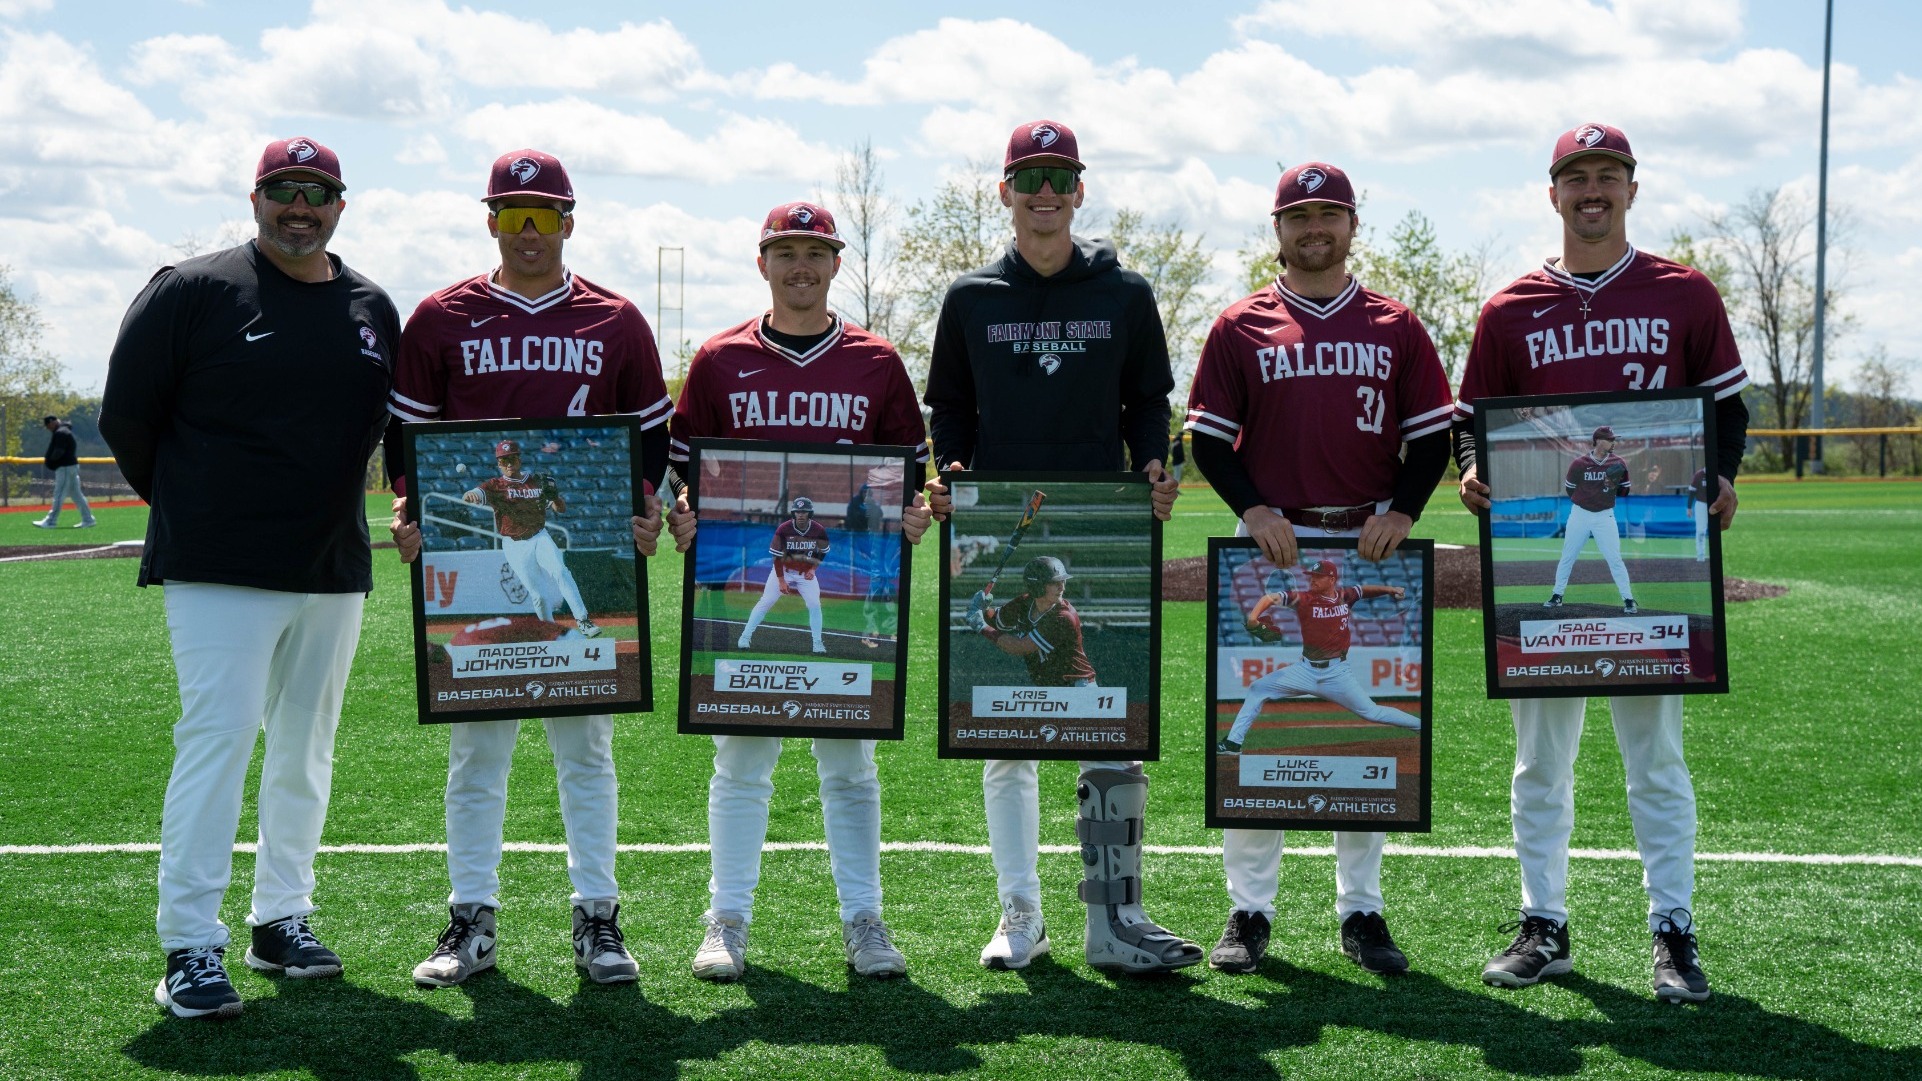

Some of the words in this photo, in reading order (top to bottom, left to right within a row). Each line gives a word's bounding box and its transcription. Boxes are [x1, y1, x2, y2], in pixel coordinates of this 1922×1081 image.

[987, 321, 1061, 343] FAIRMONT
[1066, 320, 1112, 339] STATE
[1013, 342, 1086, 352] BASEBALL
[1525, 317, 1670, 369] FALCONS
[460, 335, 604, 376] FALCONS
[1256, 341, 1392, 384] FALCONS
[566, 383, 590, 417] 4
[728, 390, 870, 432] FALCONS
[1356, 385, 1386, 435] 31
[786, 541, 817, 550] FALCONS
[1312, 603, 1349, 618] FALCONS
[1557, 622, 1607, 633] ISAAC
[1649, 624, 1685, 640] 34
[1523, 634, 1566, 648] VAN
[1571, 632, 1644, 647] METER
[478, 645, 548, 658] MADDOX
[584, 647, 601, 661] 4
[457, 655, 570, 673] JOHNSTON
[739, 664, 808, 675] CONNOR
[1506, 664, 1594, 677] BASEBALL
[1618, 663, 1691, 676] ATHLETICS
[728, 675, 820, 691] BAILEY
[841, 672, 859, 686] 9
[437, 687, 525, 701] BASEBALL
[548, 684, 617, 697] ATHLETICS
[1012, 690, 1048, 700] KRIS
[697, 703, 781, 715] BASEBALL
[991, 700, 1069, 712] SUTTON
[1096, 695, 1114, 710] 11
[803, 708, 870, 720] ATHLETICS
[956, 728, 1038, 739] BASEBALL
[1060, 732, 1126, 743] ATHLETICS
[1276, 759, 1319, 769] LUKE
[1263, 769, 1334, 782] EMORY
[1362, 765, 1389, 780] 31
[1223, 798, 1306, 809] BASEBALL
[1328, 802, 1396, 814] ATHLETICS
